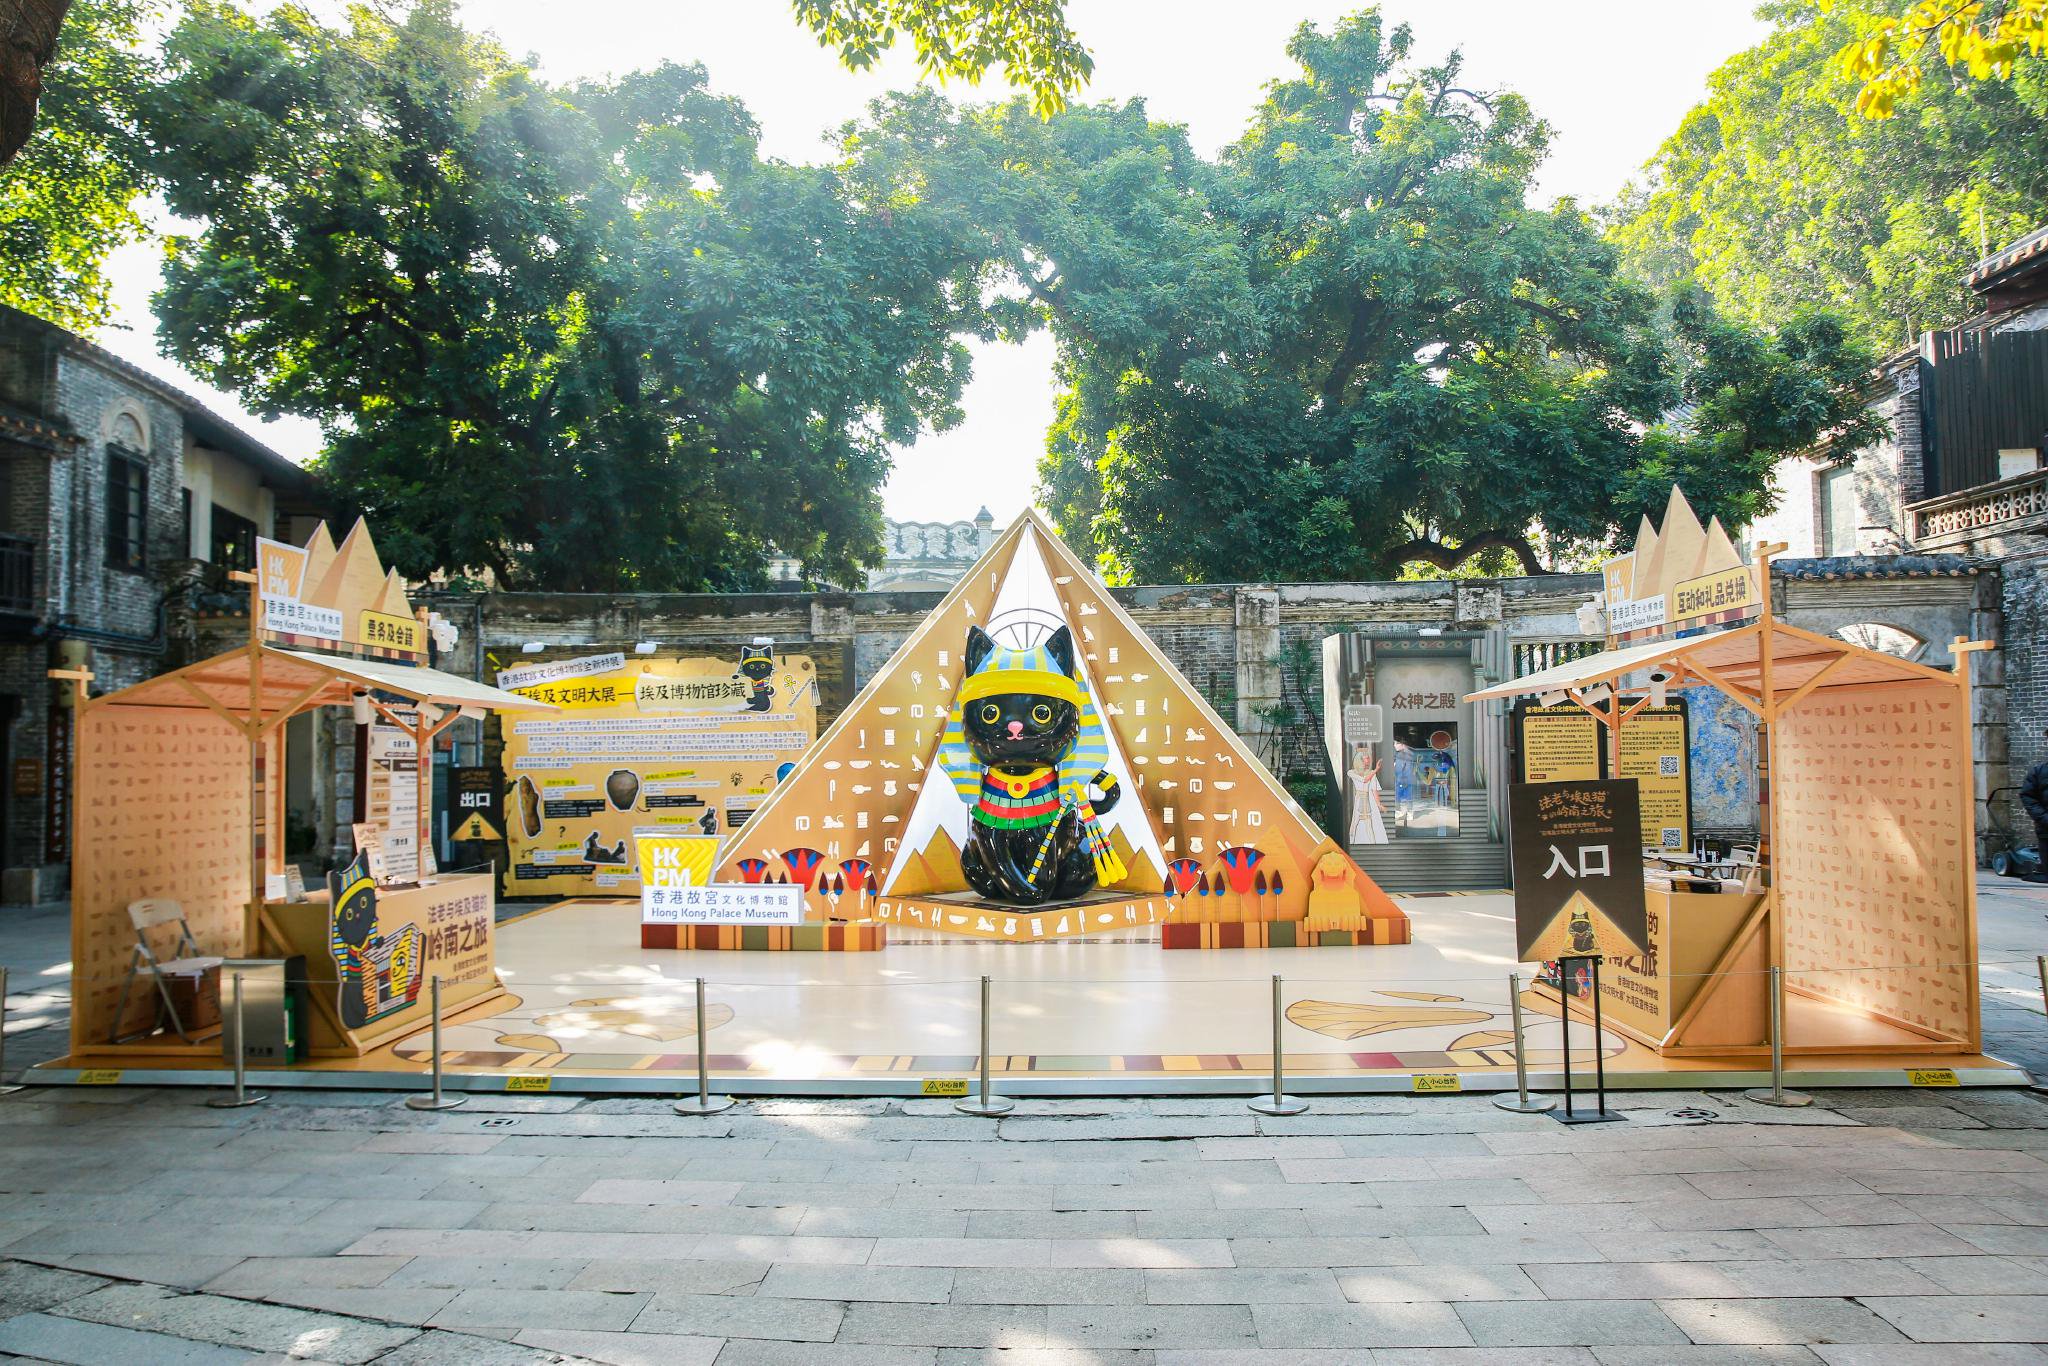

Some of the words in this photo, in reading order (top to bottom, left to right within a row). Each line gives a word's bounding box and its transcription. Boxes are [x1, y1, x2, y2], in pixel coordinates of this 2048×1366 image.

[268, 554, 285, 577] HK
[268, 576, 289, 597] PM
[1610, 568, 1621, 586] HK
[1677, 574, 1746, 614] 互动和礼品兑换
[268, 618, 283, 630] Hong
[284, 621, 299, 633] Kong
[318, 625, 341, 637] Museum
[640, 682, 746, 701] 埃及博物馆珍藏
[1391, 692, 1456, 710] 众神之殿
[460, 792, 491, 808] 出口
[653, 847, 680, 867] HK
[1542, 844, 1611, 880] 入口
[653, 868, 690, 887] PM
[652, 890, 789, 906] 香港故宮文化博物館
[652, 907, 678, 920] Hong
[681, 908, 707, 920] Kong
[710, 908, 742, 919] Palace
[745, 908, 789, 919] Museum
[427, 916, 488, 962] 岭南之旅
